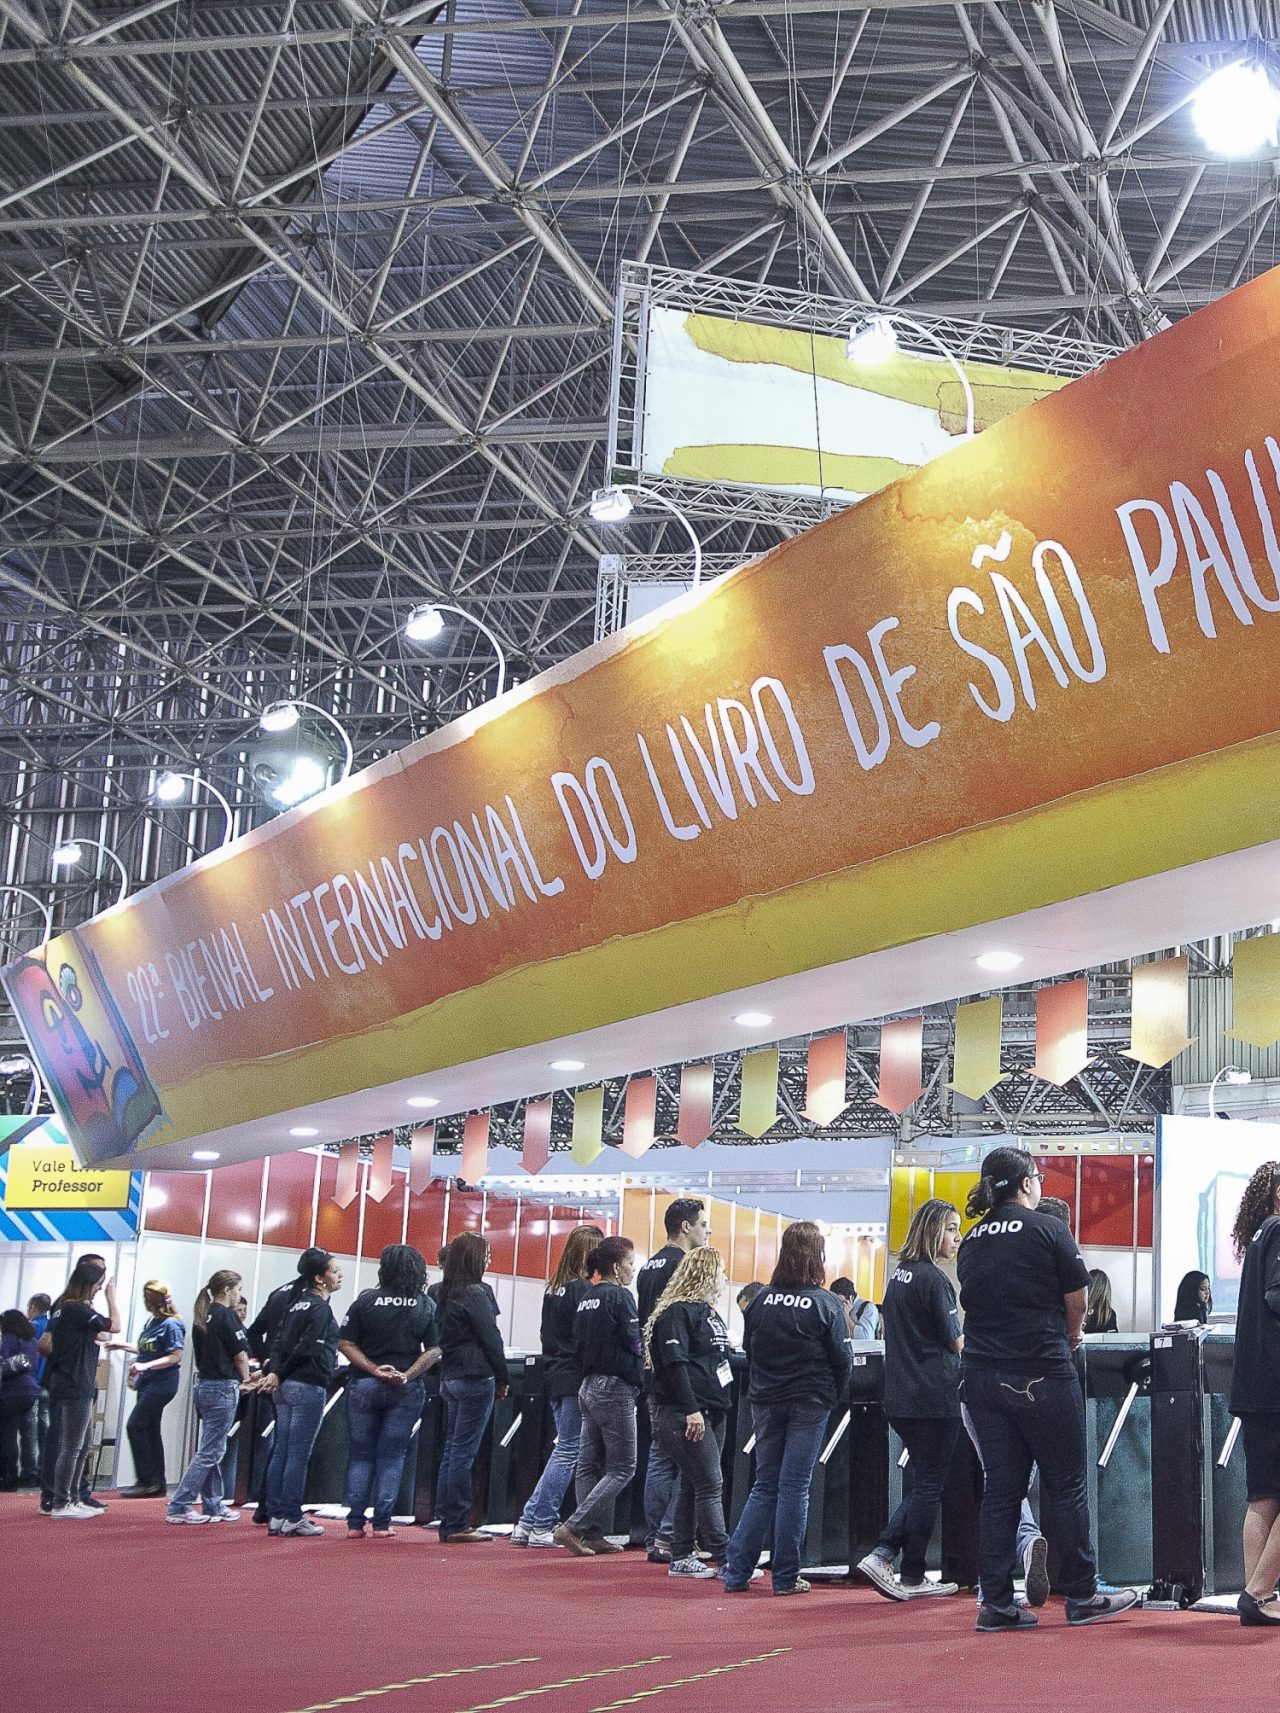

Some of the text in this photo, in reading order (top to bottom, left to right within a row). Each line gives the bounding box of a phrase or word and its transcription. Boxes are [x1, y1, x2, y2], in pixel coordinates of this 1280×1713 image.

[163, 922, 274, 1031] BIENAL
[261, 794, 565, 990] INTERNACIONAL
[550, 757, 638, 880] DO
[637, 676, 816, 840] LIVRO
[822, 616, 941, 770] DE
[946, 530, 1107, 722] SÃO
[32, 1160, 66, 1173] Vale
[31, 1179, 104, 1193] Professor
[966, 1220, 1023, 1240] APOIO
[892, 1268, 913, 1284] POIO
[373, 1296, 418, 1307] APOIO
[576, 1298, 601, 1313] APOIO
[762, 1293, 813, 1310] APOIO
[1159, 1338, 1166, 1347] 7
